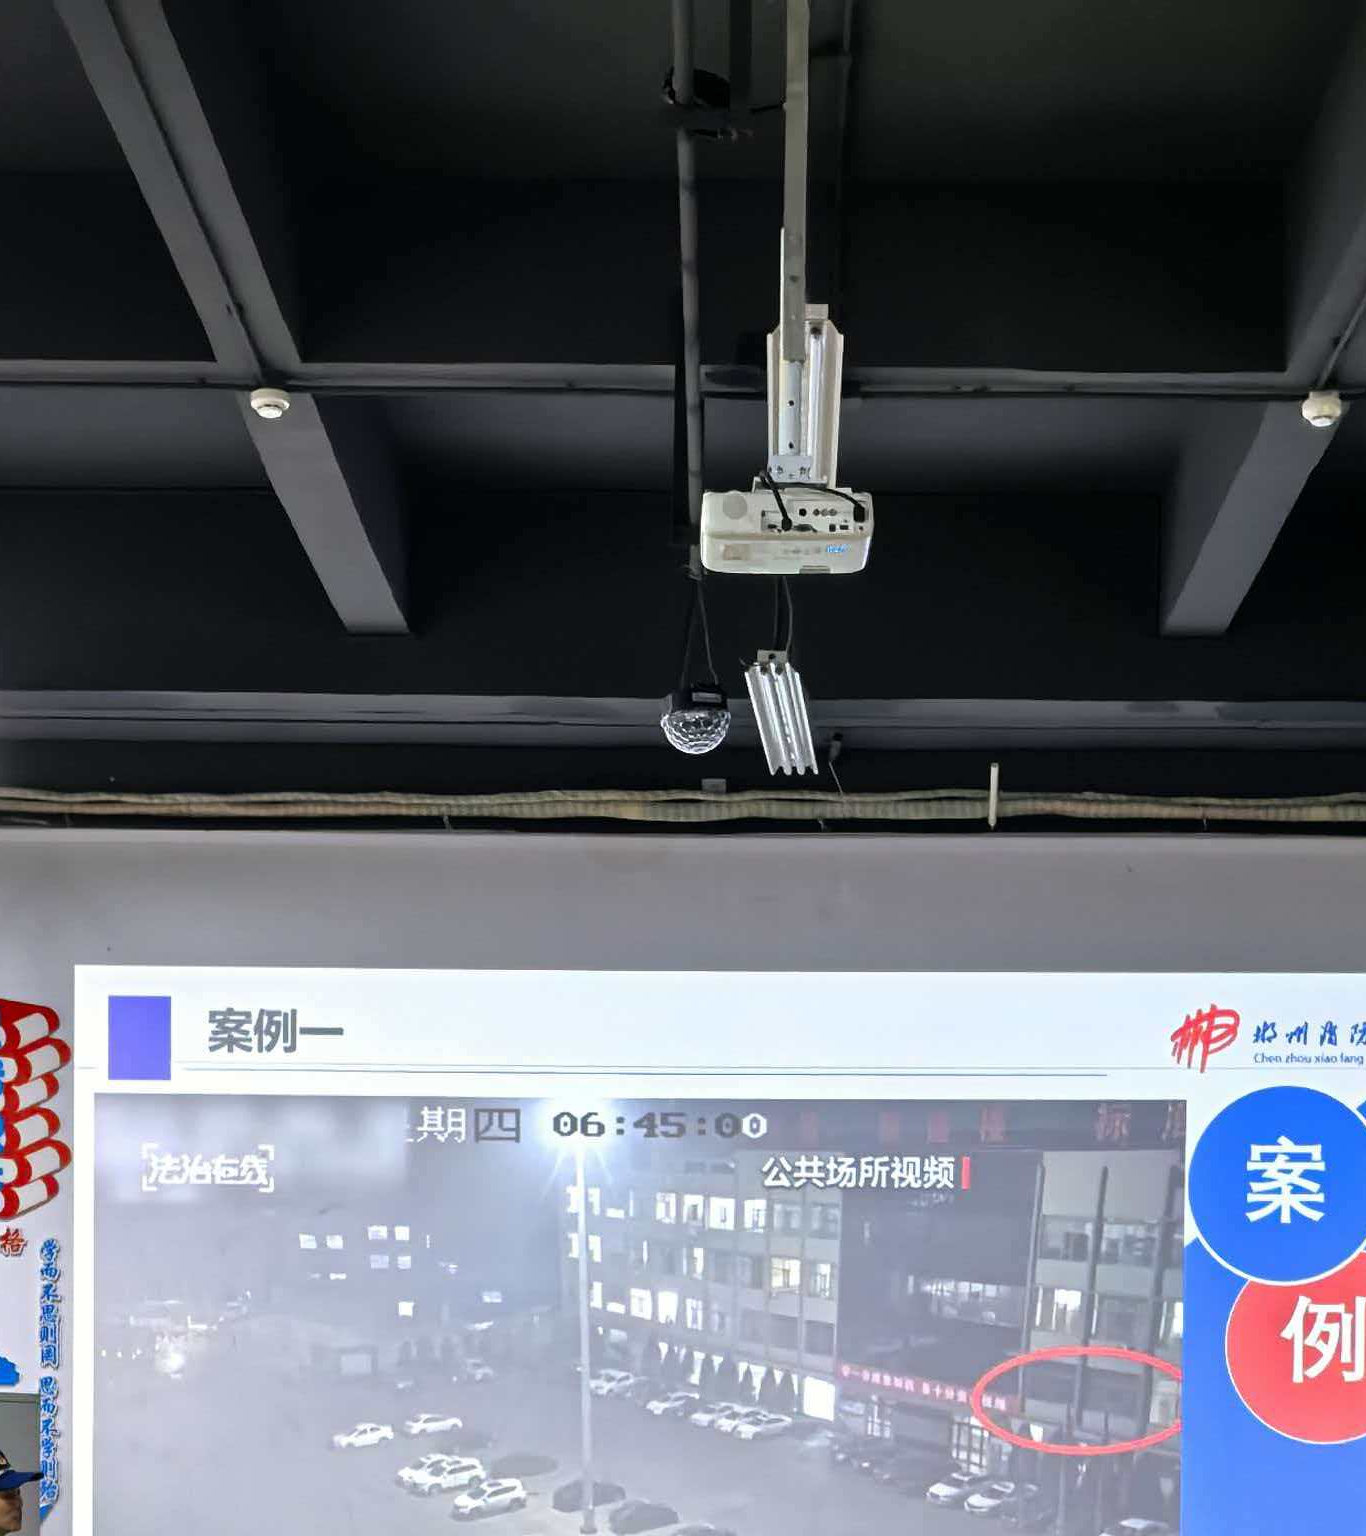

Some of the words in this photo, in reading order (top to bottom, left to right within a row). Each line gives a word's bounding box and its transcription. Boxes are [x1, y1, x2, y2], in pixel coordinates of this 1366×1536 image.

[208, 1007, 344, 1053] 案例一
[404, 1105, 522, 1143] 期四
[552, 1111, 767, 1138] 06:45:00
[149, 1154, 269, 1186] 法治在线
[761, 1156, 956, 1188] 公共场所视频
[1246, 1136, 1326, 1224] 案
[1280, 1295, 1366, 1384] 例
